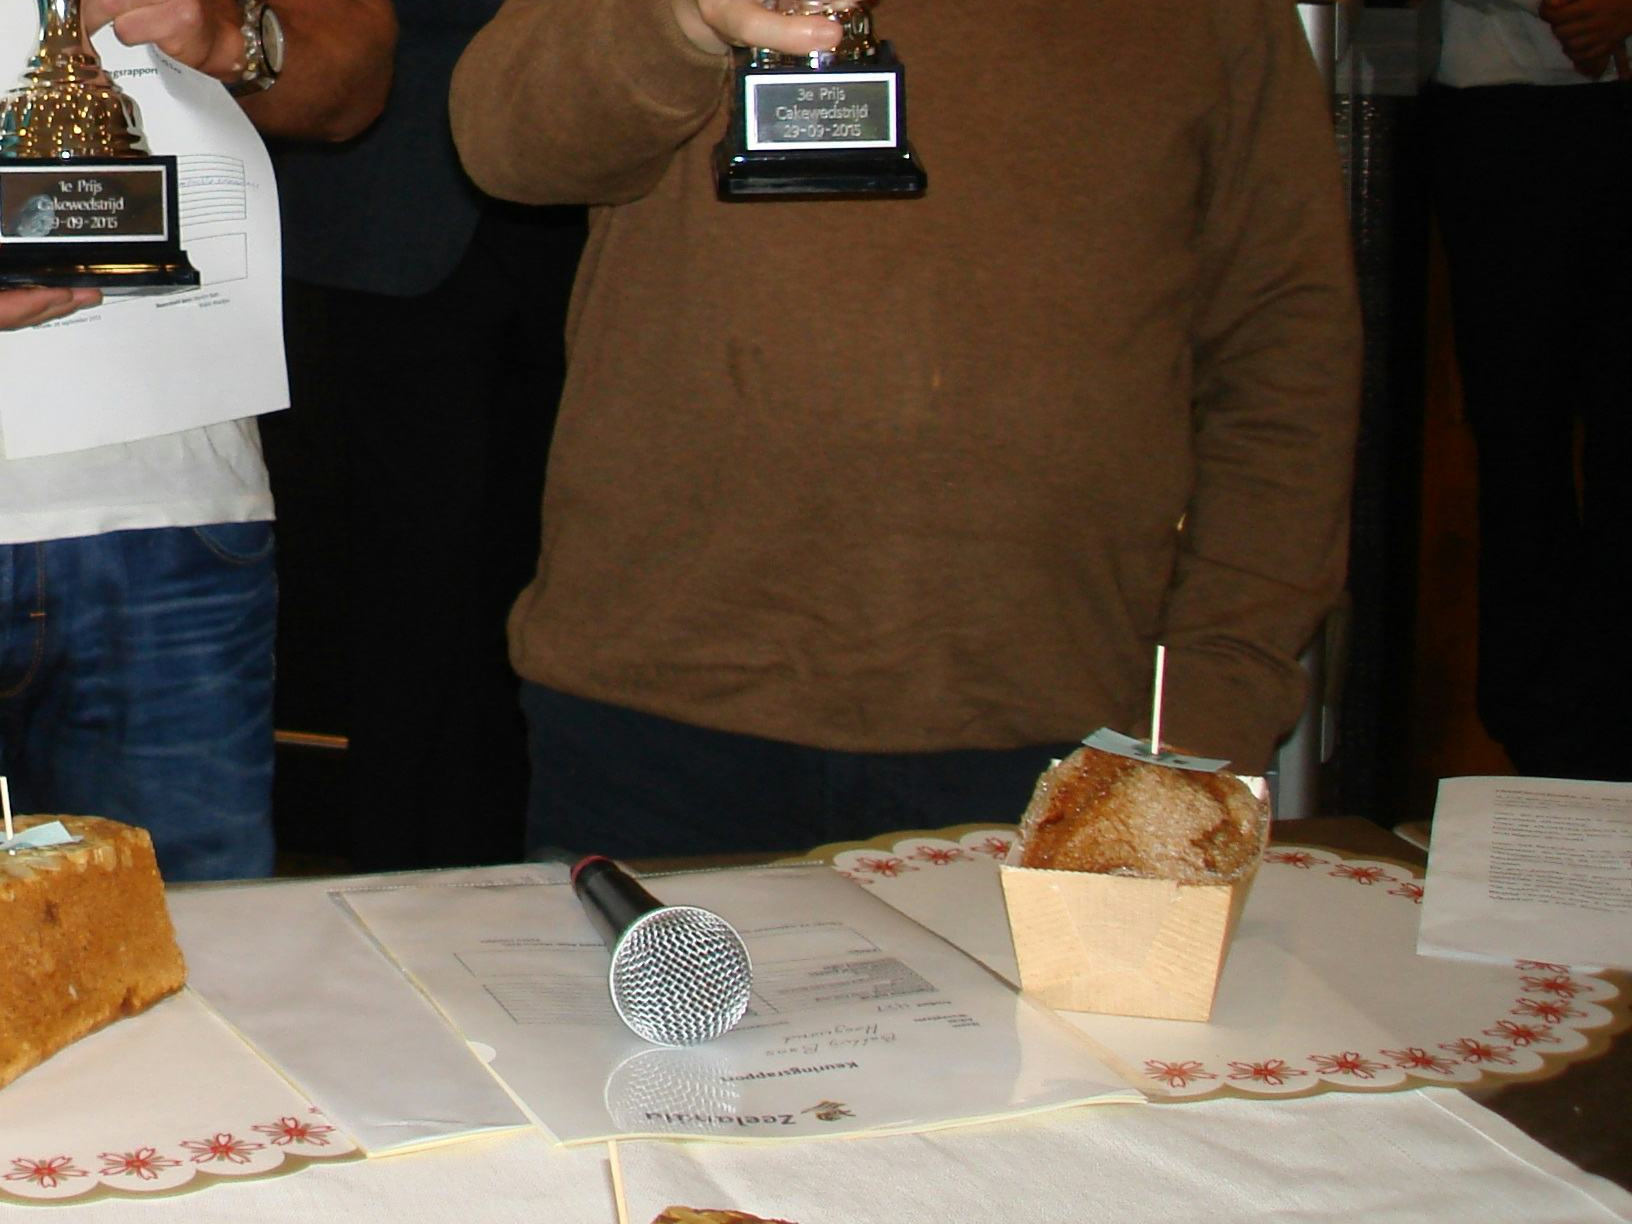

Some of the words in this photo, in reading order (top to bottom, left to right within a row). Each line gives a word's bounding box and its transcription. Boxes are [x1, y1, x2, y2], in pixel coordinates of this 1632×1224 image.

[109, 67, 158, 79] gsrapport
[797, 87, 814, 102] 3e
[819, 86, 846, 104] Prijs
[775, 103, 869, 123] Cakewedstrijd
[58, 180, 73, 193] 1e
[78, 179, 103, 196] Prijs
[719, 1060, 859, 1082] Keuringsrapport
